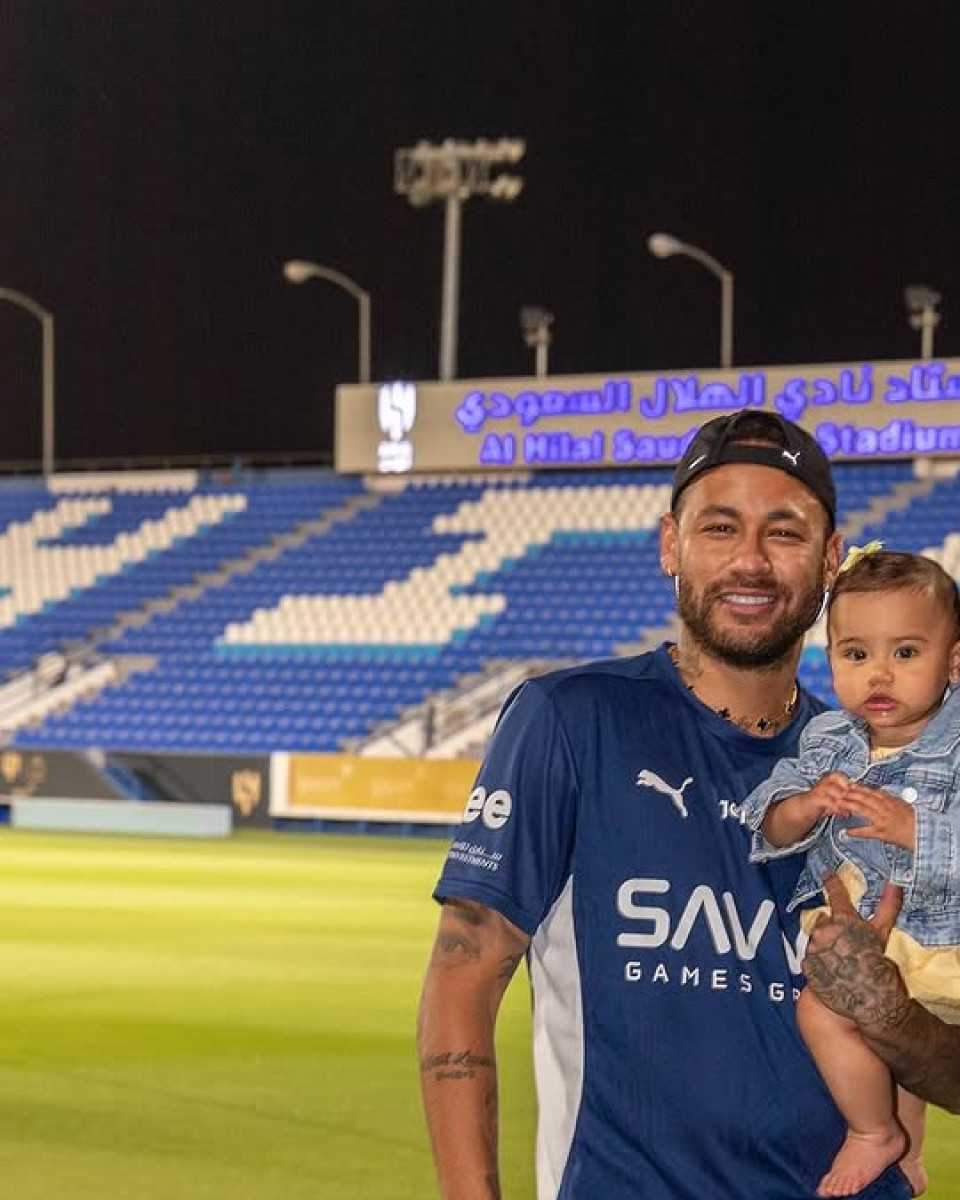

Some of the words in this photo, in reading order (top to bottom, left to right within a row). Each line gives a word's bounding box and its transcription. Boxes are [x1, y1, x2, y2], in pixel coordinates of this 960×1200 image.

[455, 378, 632, 434] السعودي
[639, 371, 766, 420] الهلال
[773, 362, 874, 422] نادي
[479, 432, 516, 465] Al
[522, 429, 604, 465] Hilal
[616, 878, 810, 976] SAVV
[625, 961, 752, 993] GAMES
